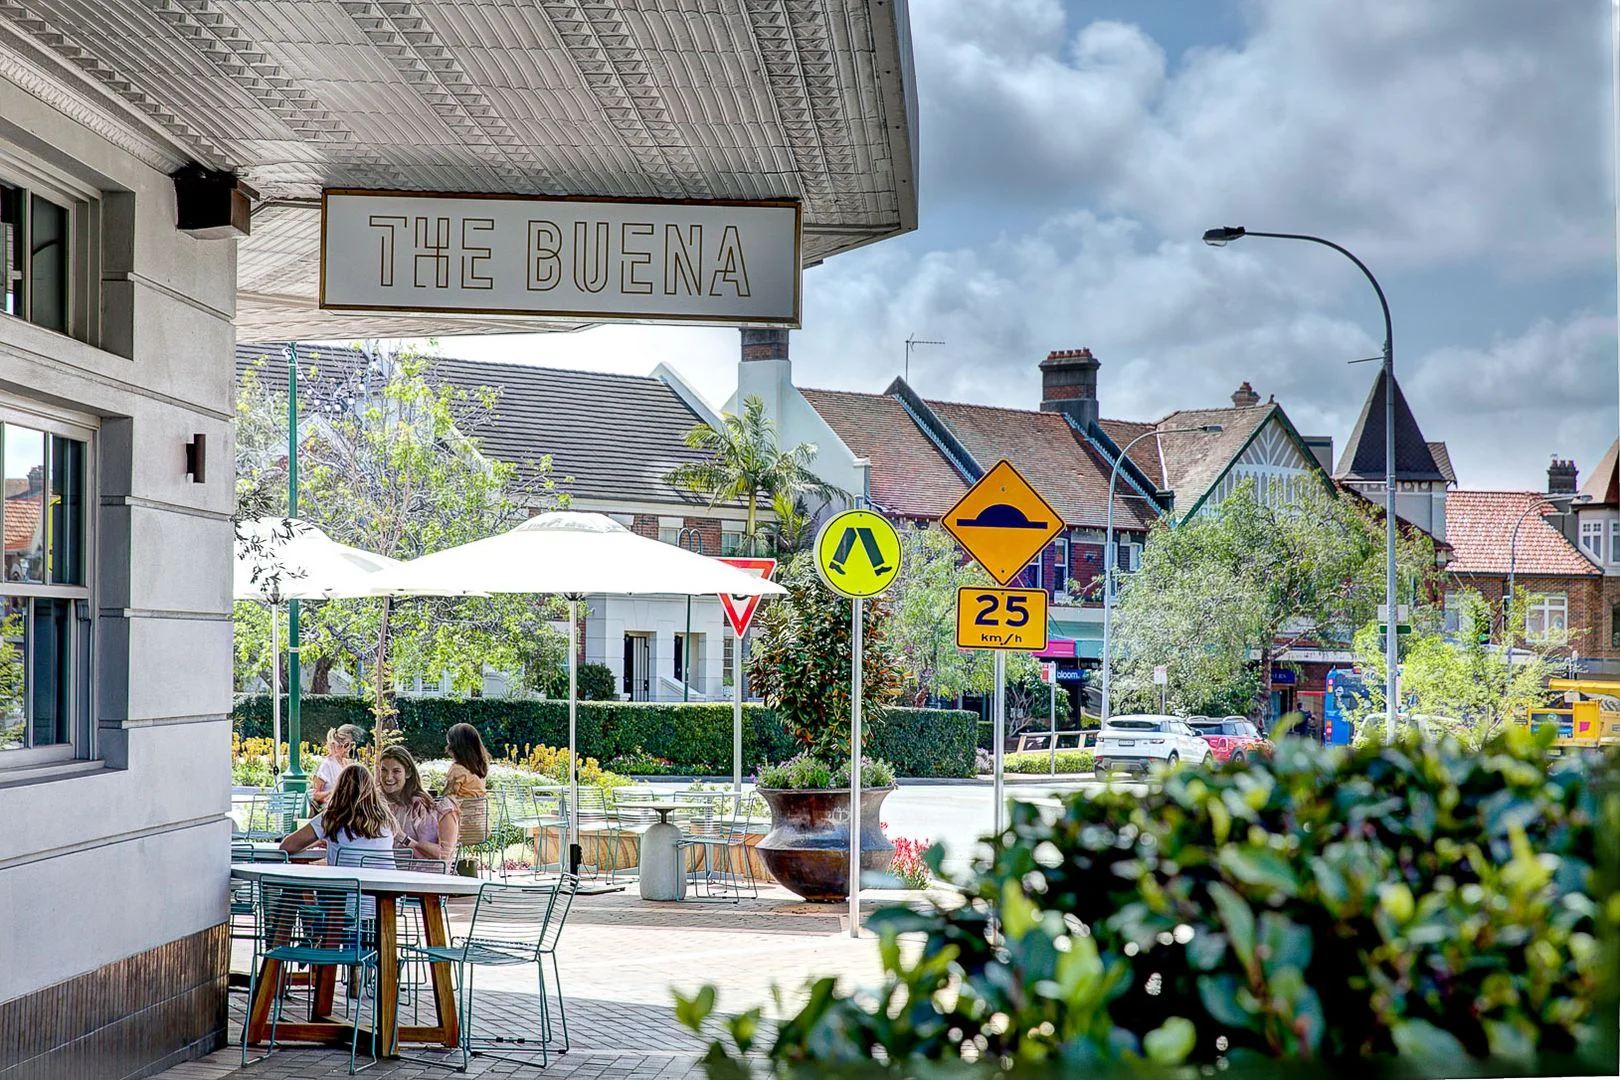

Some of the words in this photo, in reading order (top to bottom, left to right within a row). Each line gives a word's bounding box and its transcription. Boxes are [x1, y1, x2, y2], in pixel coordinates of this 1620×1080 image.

[369, 215, 495, 290] THE
[526, 219, 752, 298] BUENA
[974, 594, 1030, 627] 25
[981, 633, 1022, 645] km/h
